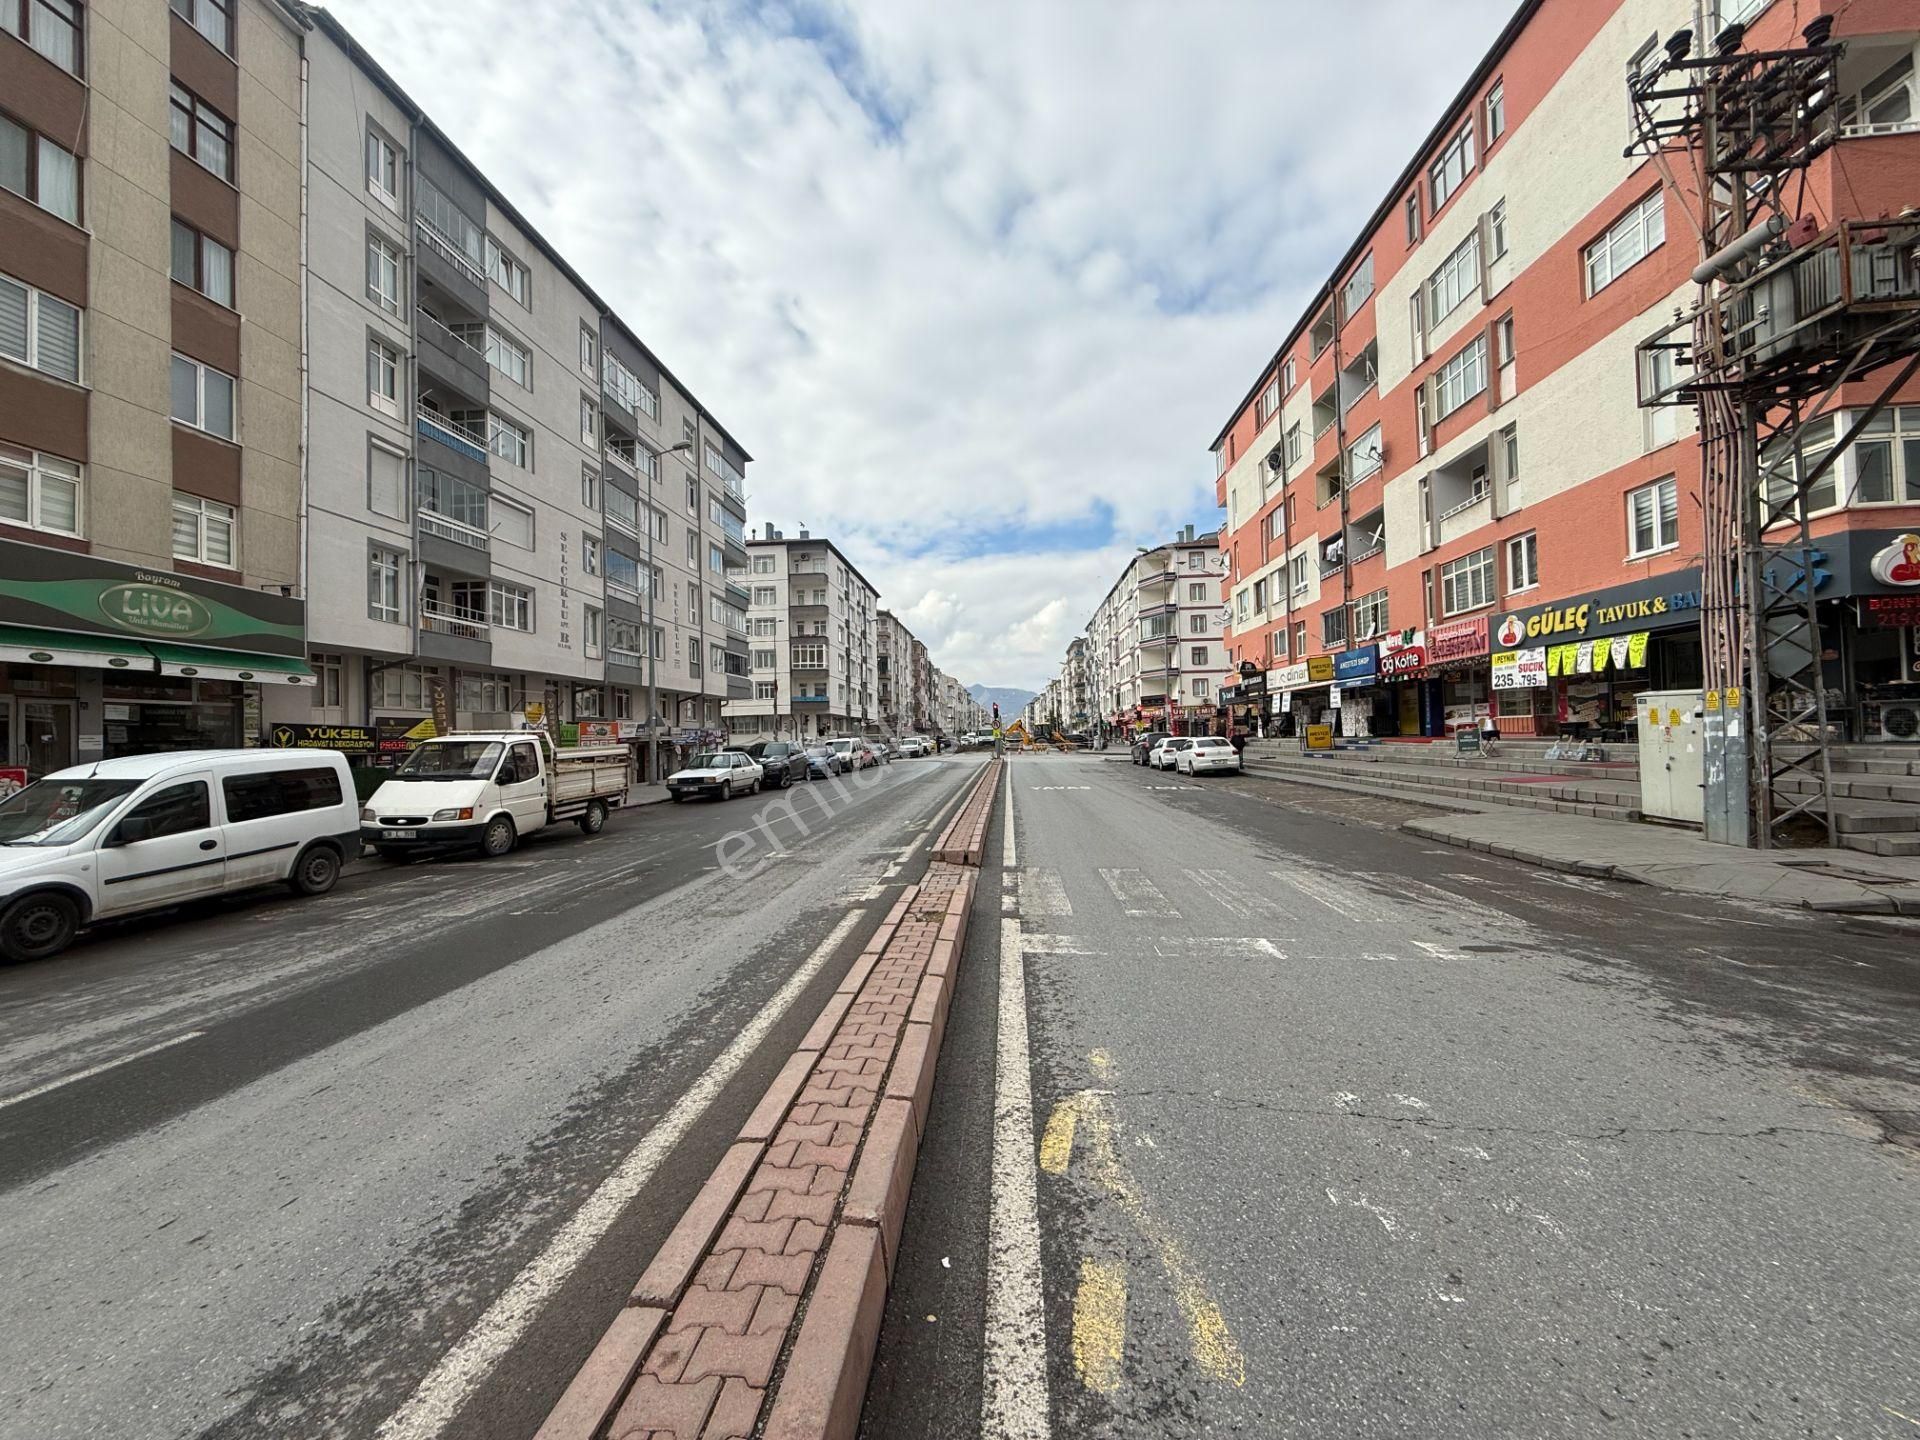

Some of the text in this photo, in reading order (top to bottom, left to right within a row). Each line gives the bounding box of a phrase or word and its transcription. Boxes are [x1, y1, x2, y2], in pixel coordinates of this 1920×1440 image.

[134, 571, 181, 588] Bayram
[1526, 603, 1589, 638] GÜLEÇ
[1596, 600, 1651, 624] TAVUK
[1652, 596, 1668, 613] &
[1395, 651, 1419, 669] Köfte
[1518, 661, 1544, 673] SUCUK
[1494, 673, 1514, 688] 235
[1521, 674, 1538, 686] 795
[306, 725, 369, 740] YÜKSEL
[334, 740, 375, 749] DEKORASYON
